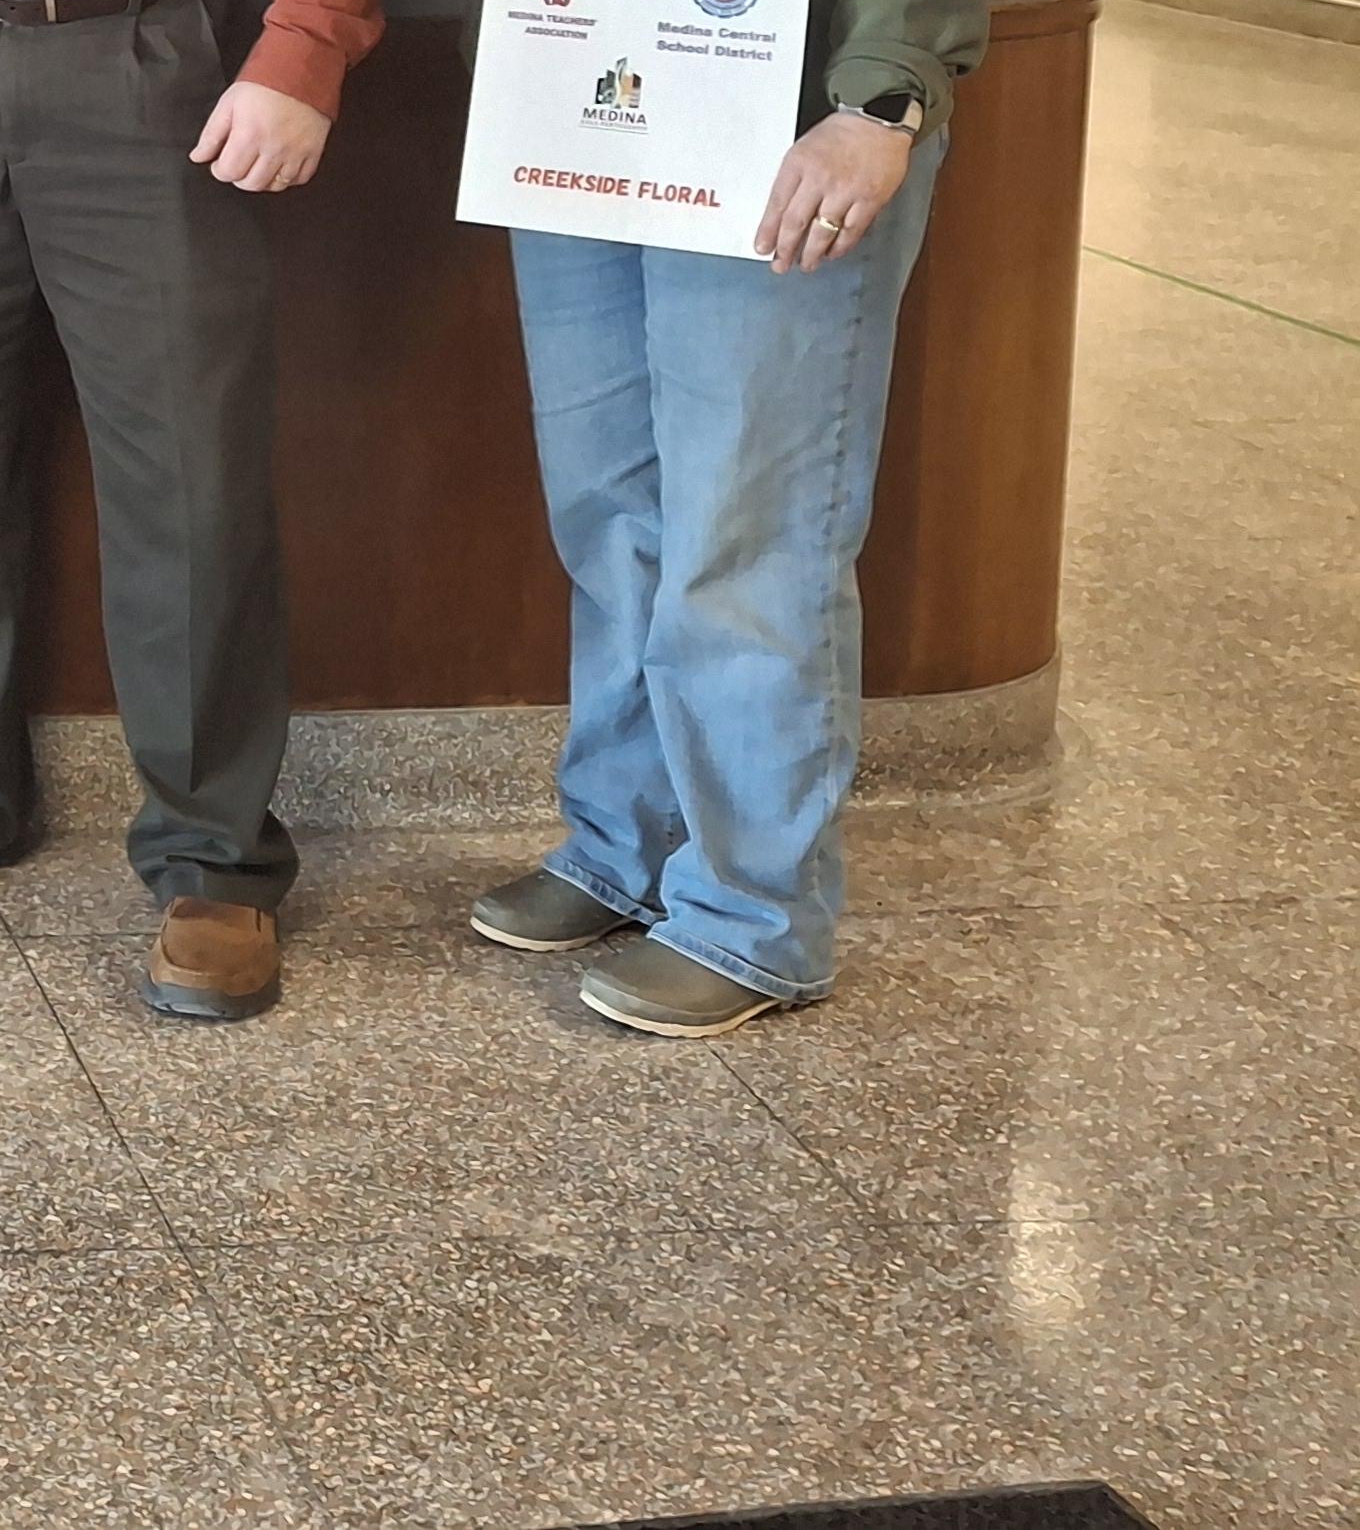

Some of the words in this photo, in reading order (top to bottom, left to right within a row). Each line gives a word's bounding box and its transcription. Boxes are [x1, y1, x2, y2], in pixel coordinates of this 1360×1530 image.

[657, 22, 713, 38] Medina
[718, 27, 777, 43] Central
[656, 40, 710, 55] School
[714, 47, 773, 62] District
[583, 107, 647, 126] MEDINA
[514, 165, 630, 197] CREEKSIDE
[637, 181, 722, 208] FLORAL
